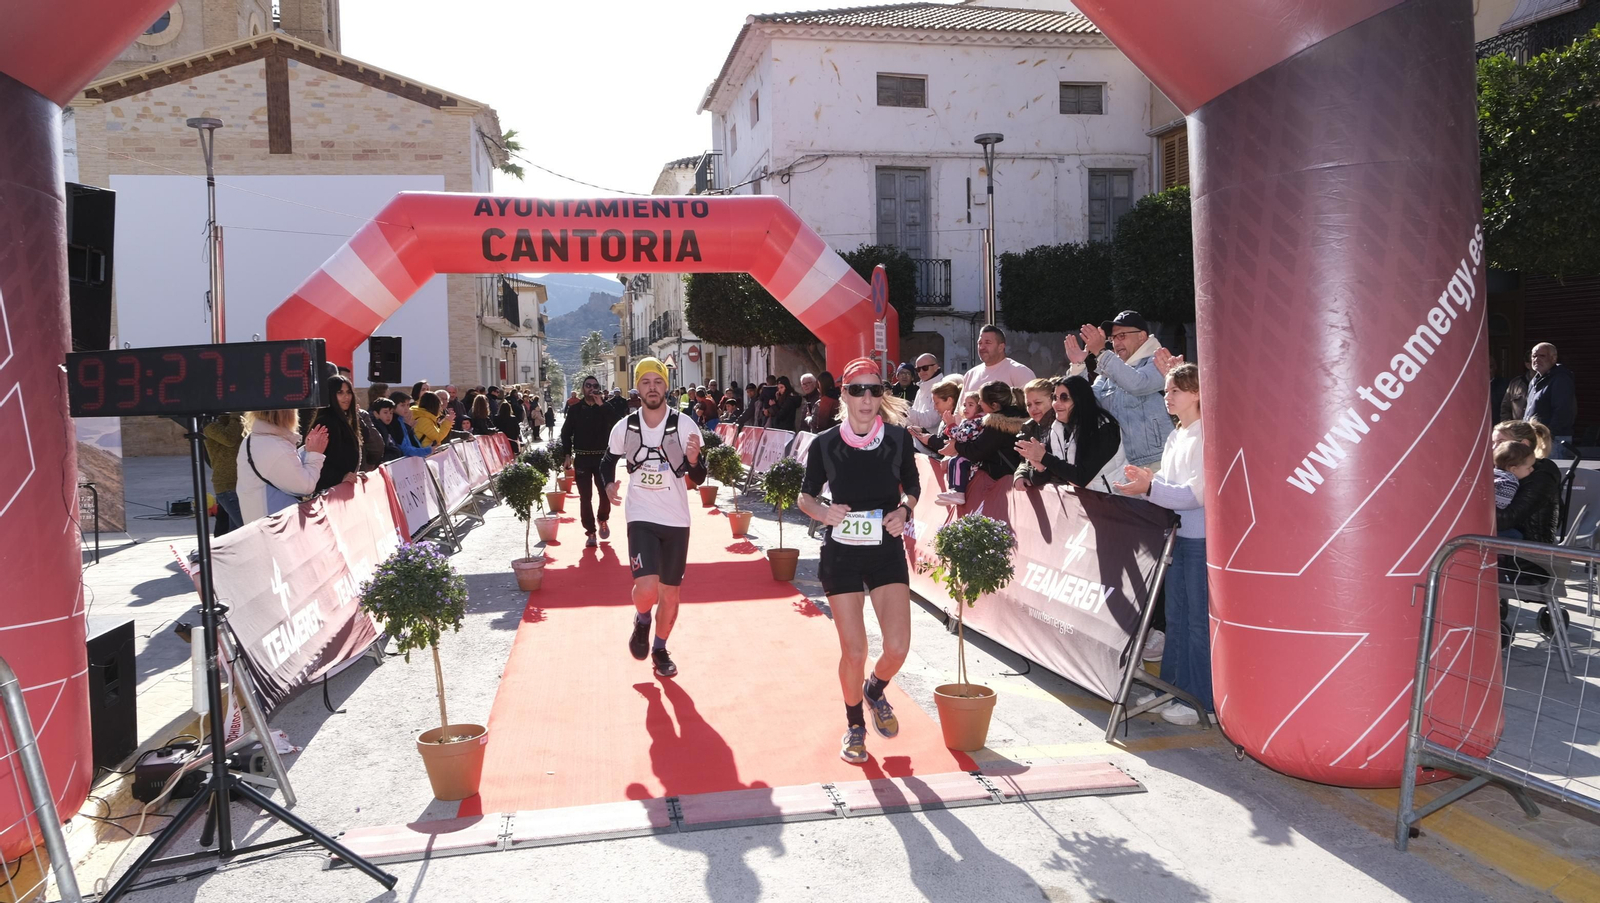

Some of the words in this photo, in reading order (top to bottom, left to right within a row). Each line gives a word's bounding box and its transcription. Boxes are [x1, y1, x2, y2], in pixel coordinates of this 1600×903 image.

[474, 198, 709, 218] AYUNTAMIENTO
[481, 227, 703, 263] CANTORIA
[1286, 223, 1484, 495] www.teamergy.es
[640, 472, 663, 485] 252
[841, 519, 873, 536] 219
[1020, 562, 1115, 614] TEAMERGY
[262, 598, 325, 669] TEAMERGY
